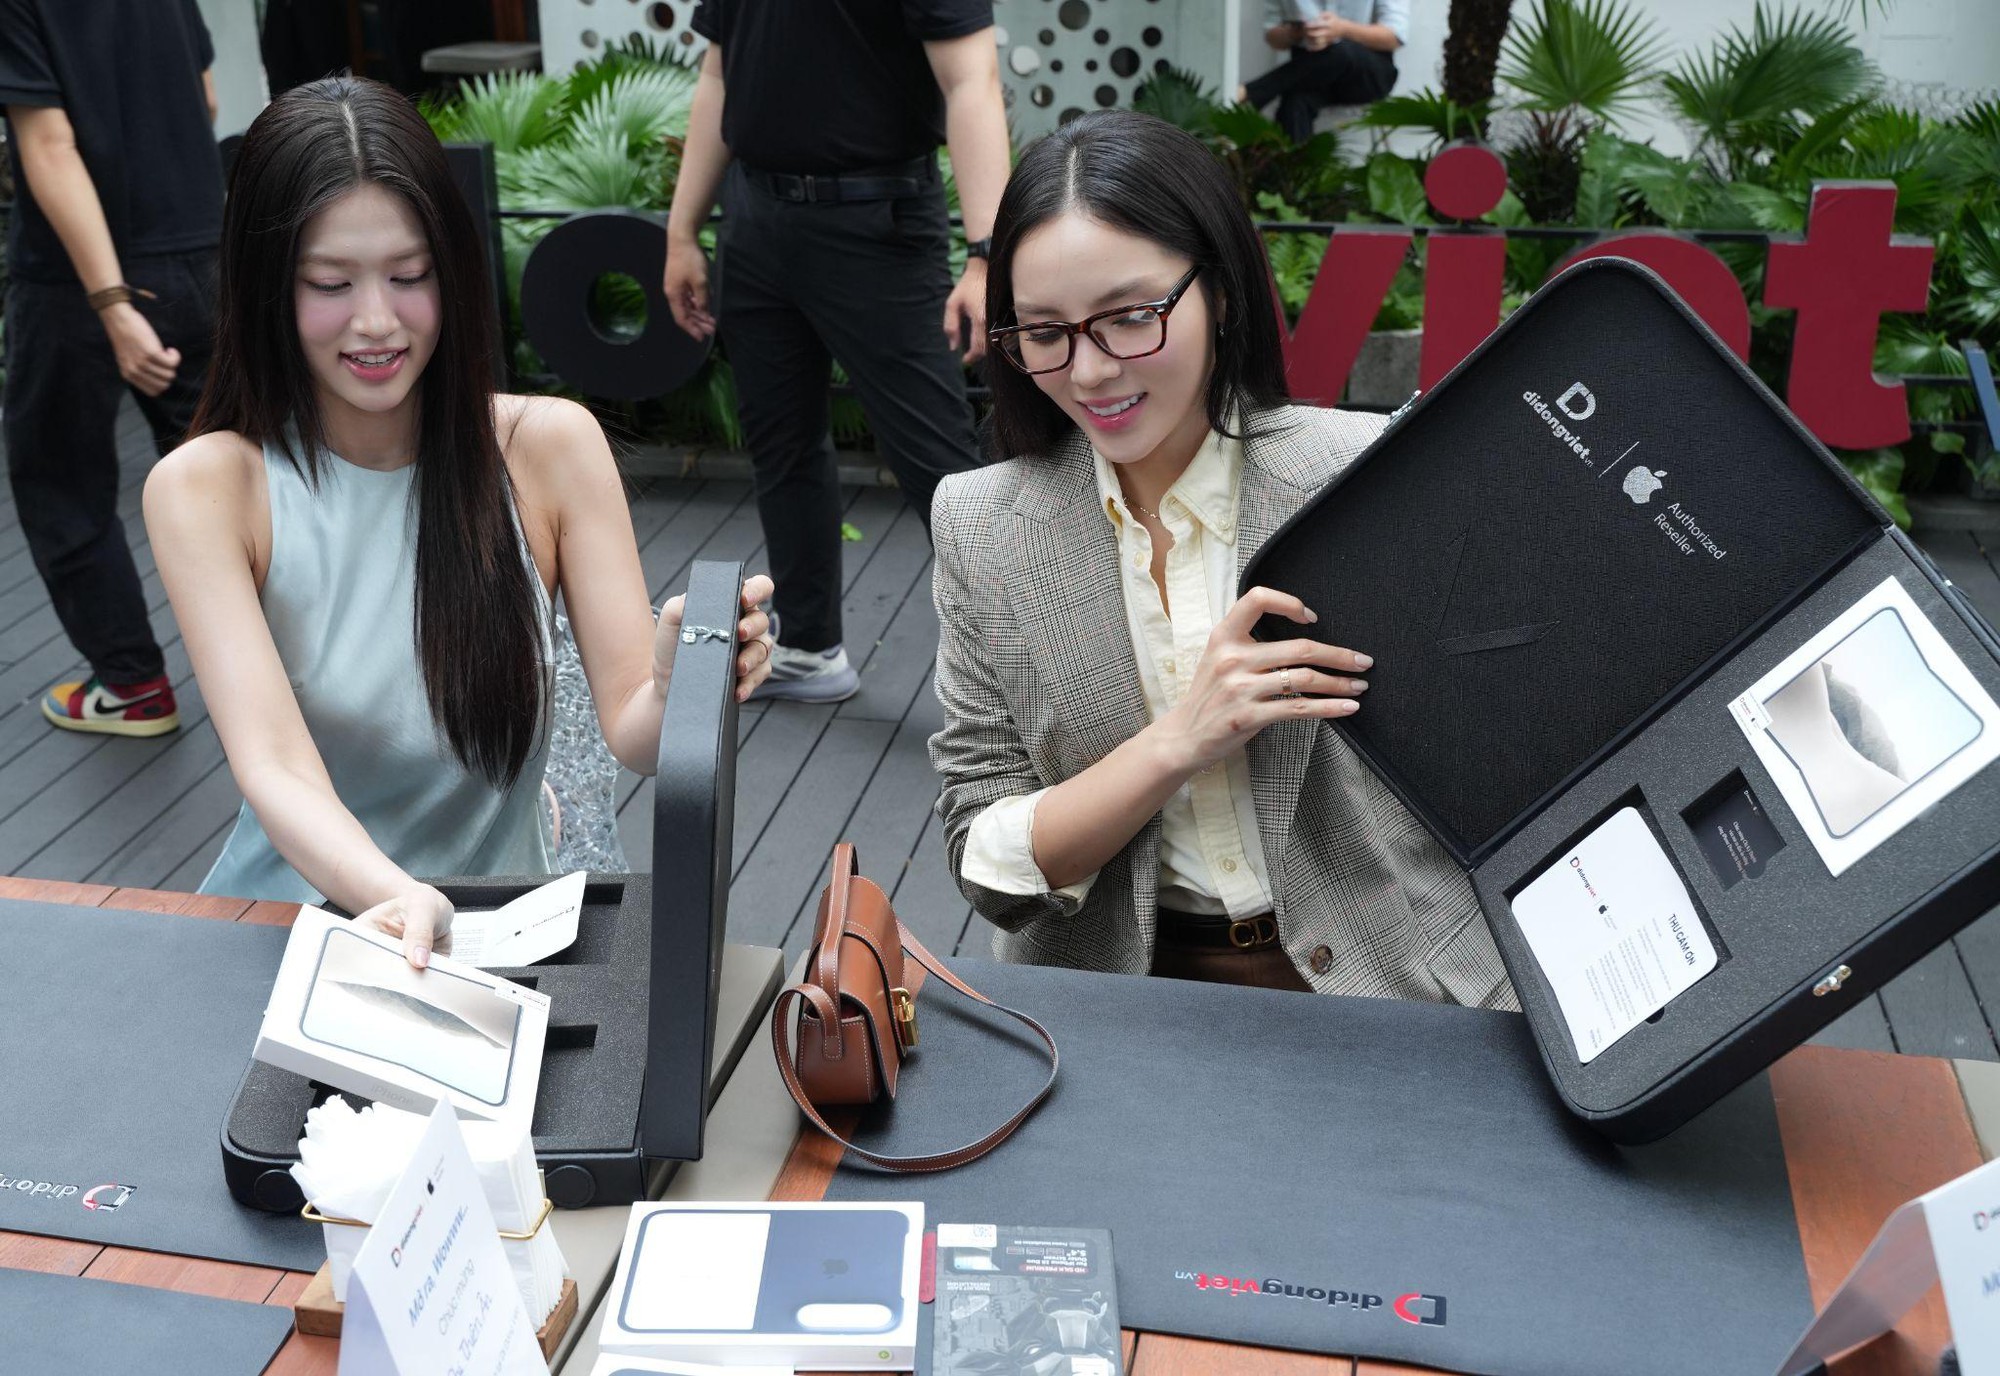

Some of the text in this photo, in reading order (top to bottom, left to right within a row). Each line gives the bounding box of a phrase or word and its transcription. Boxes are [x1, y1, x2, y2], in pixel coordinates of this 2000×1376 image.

[1653, 512, 1695, 556] Reseller
[1667, 502, 1727, 560] Authorized
[1175, 1270, 1383, 1312] didongviet.vn
